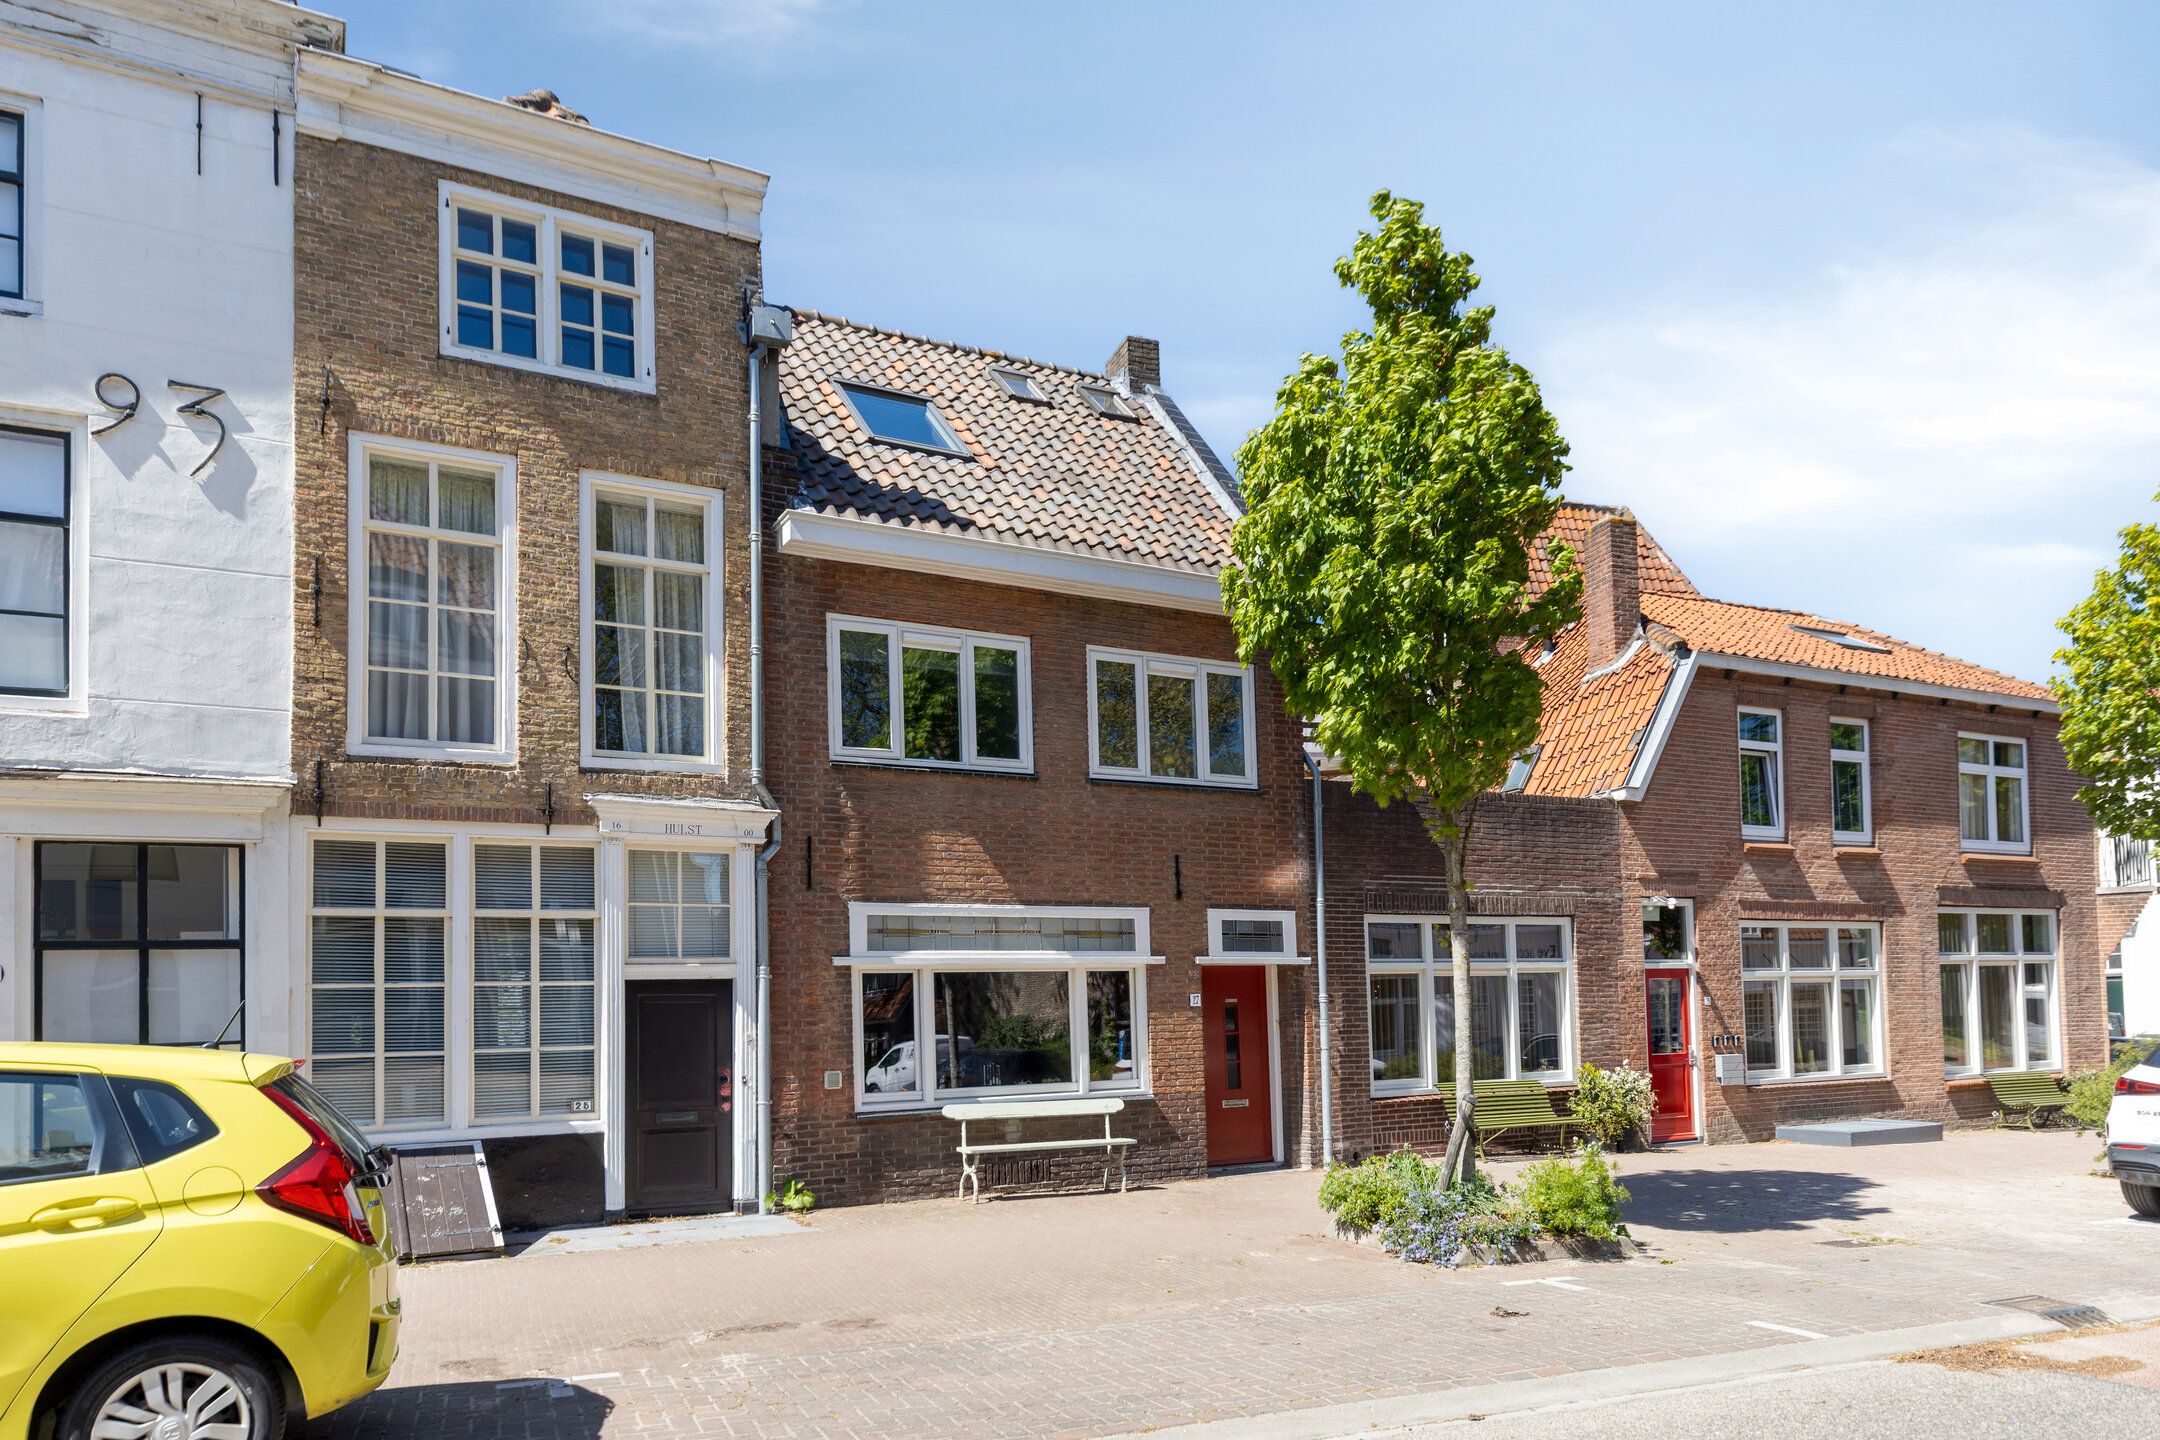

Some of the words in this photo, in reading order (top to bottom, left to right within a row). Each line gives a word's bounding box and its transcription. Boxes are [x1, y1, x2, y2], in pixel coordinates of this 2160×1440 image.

[91, 373, 225, 477] 93
[612, 821, 622, 830] 16
[665, 824, 703, 836] HULST
[743, 829, 754, 837] 00
[575, 1101, 590, 1110] 25
